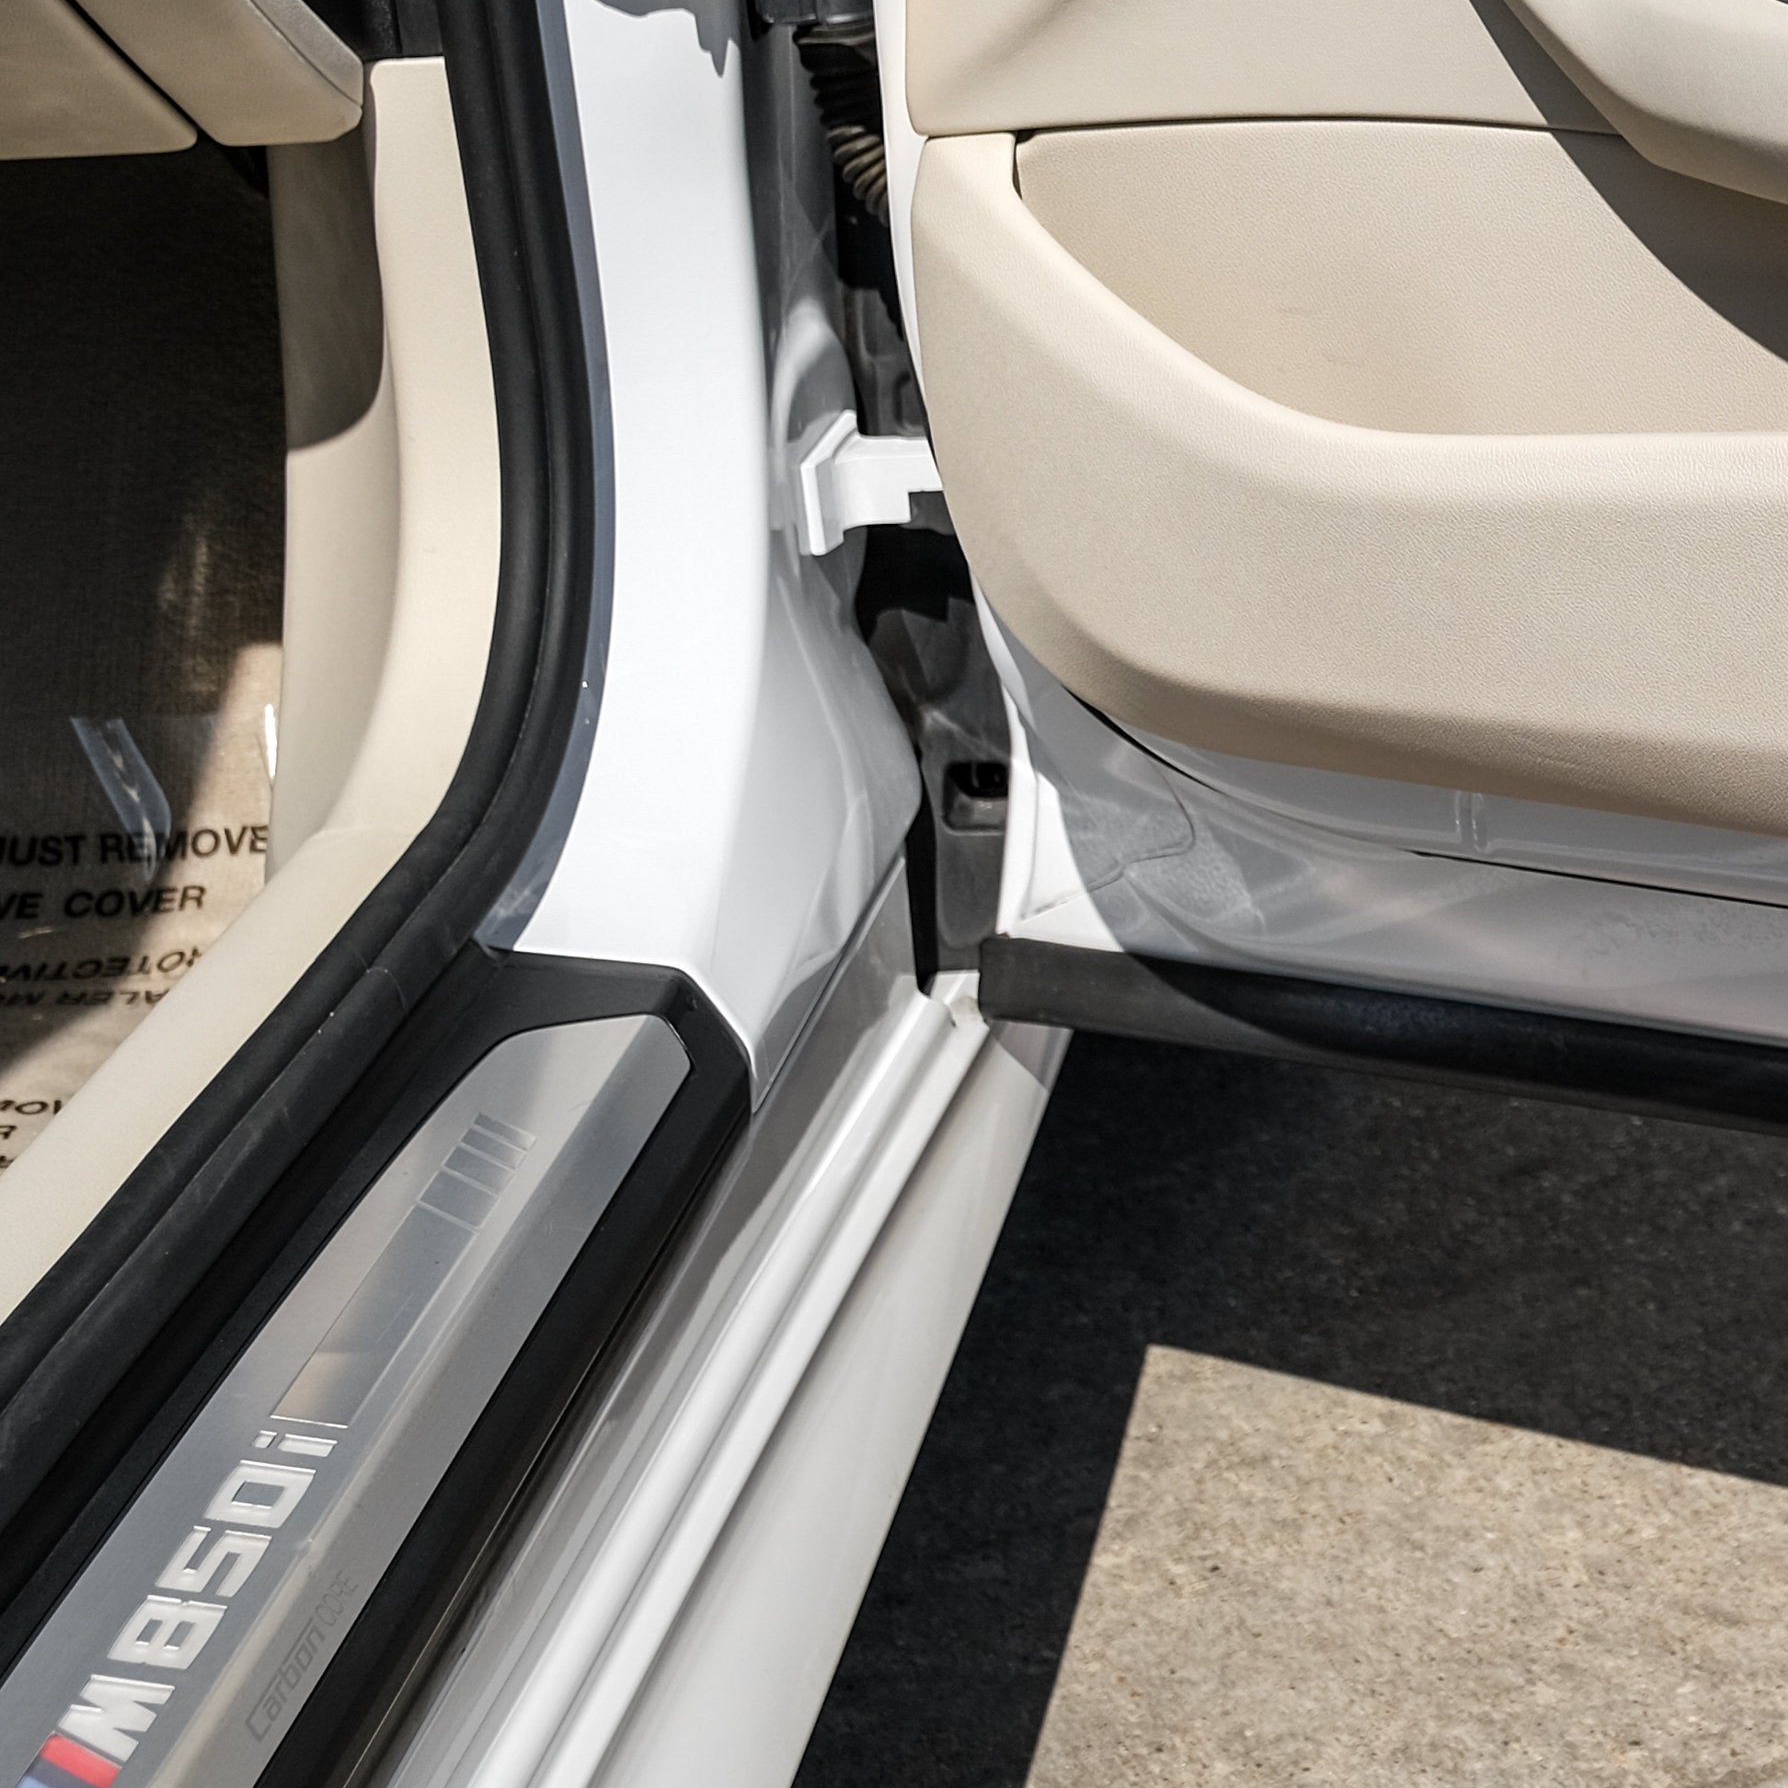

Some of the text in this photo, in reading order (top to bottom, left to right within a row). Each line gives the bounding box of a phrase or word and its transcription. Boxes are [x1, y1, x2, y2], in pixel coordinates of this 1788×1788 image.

[100, 824, 269, 863] REMOVE
[63, 885, 207, 919] COVER
[58, 1430, 338, 1763] M850i
